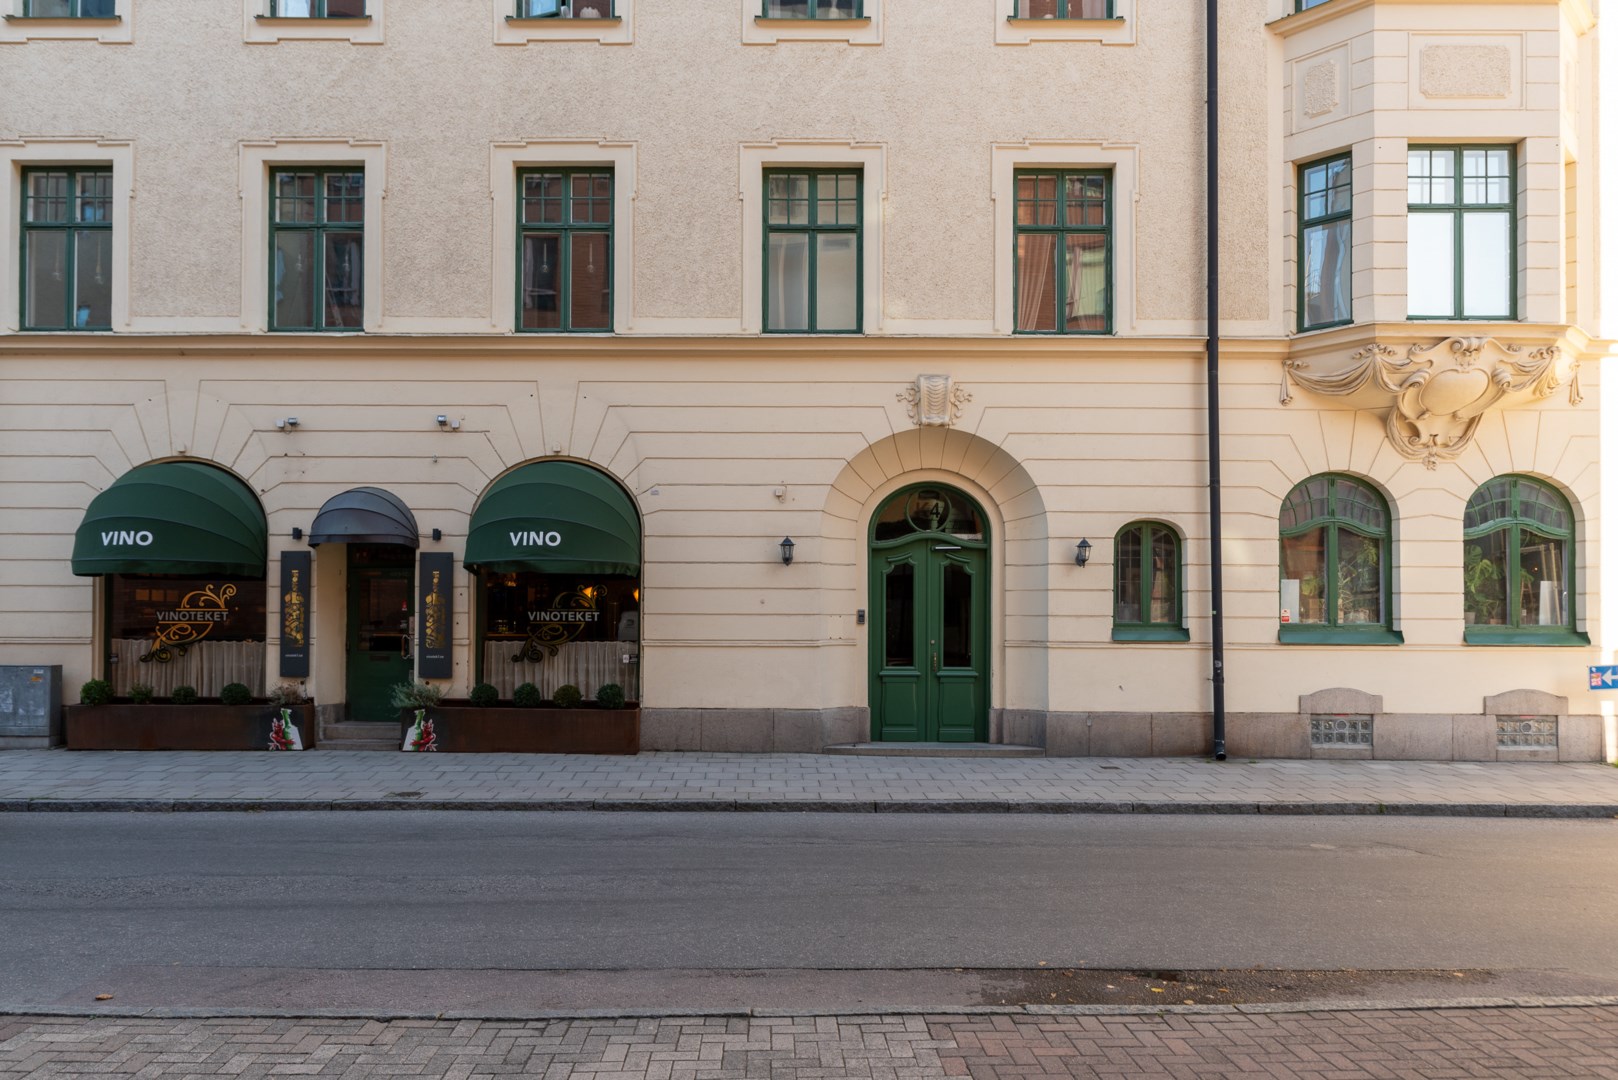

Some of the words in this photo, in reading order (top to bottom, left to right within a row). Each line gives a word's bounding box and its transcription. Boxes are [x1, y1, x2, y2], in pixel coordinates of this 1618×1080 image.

[101, 530, 154, 546] VINO
[509, 531, 561, 547] VINO
[156, 611, 229, 621] VINOTEKET
[527, 611, 600, 622] VINOTEKET
